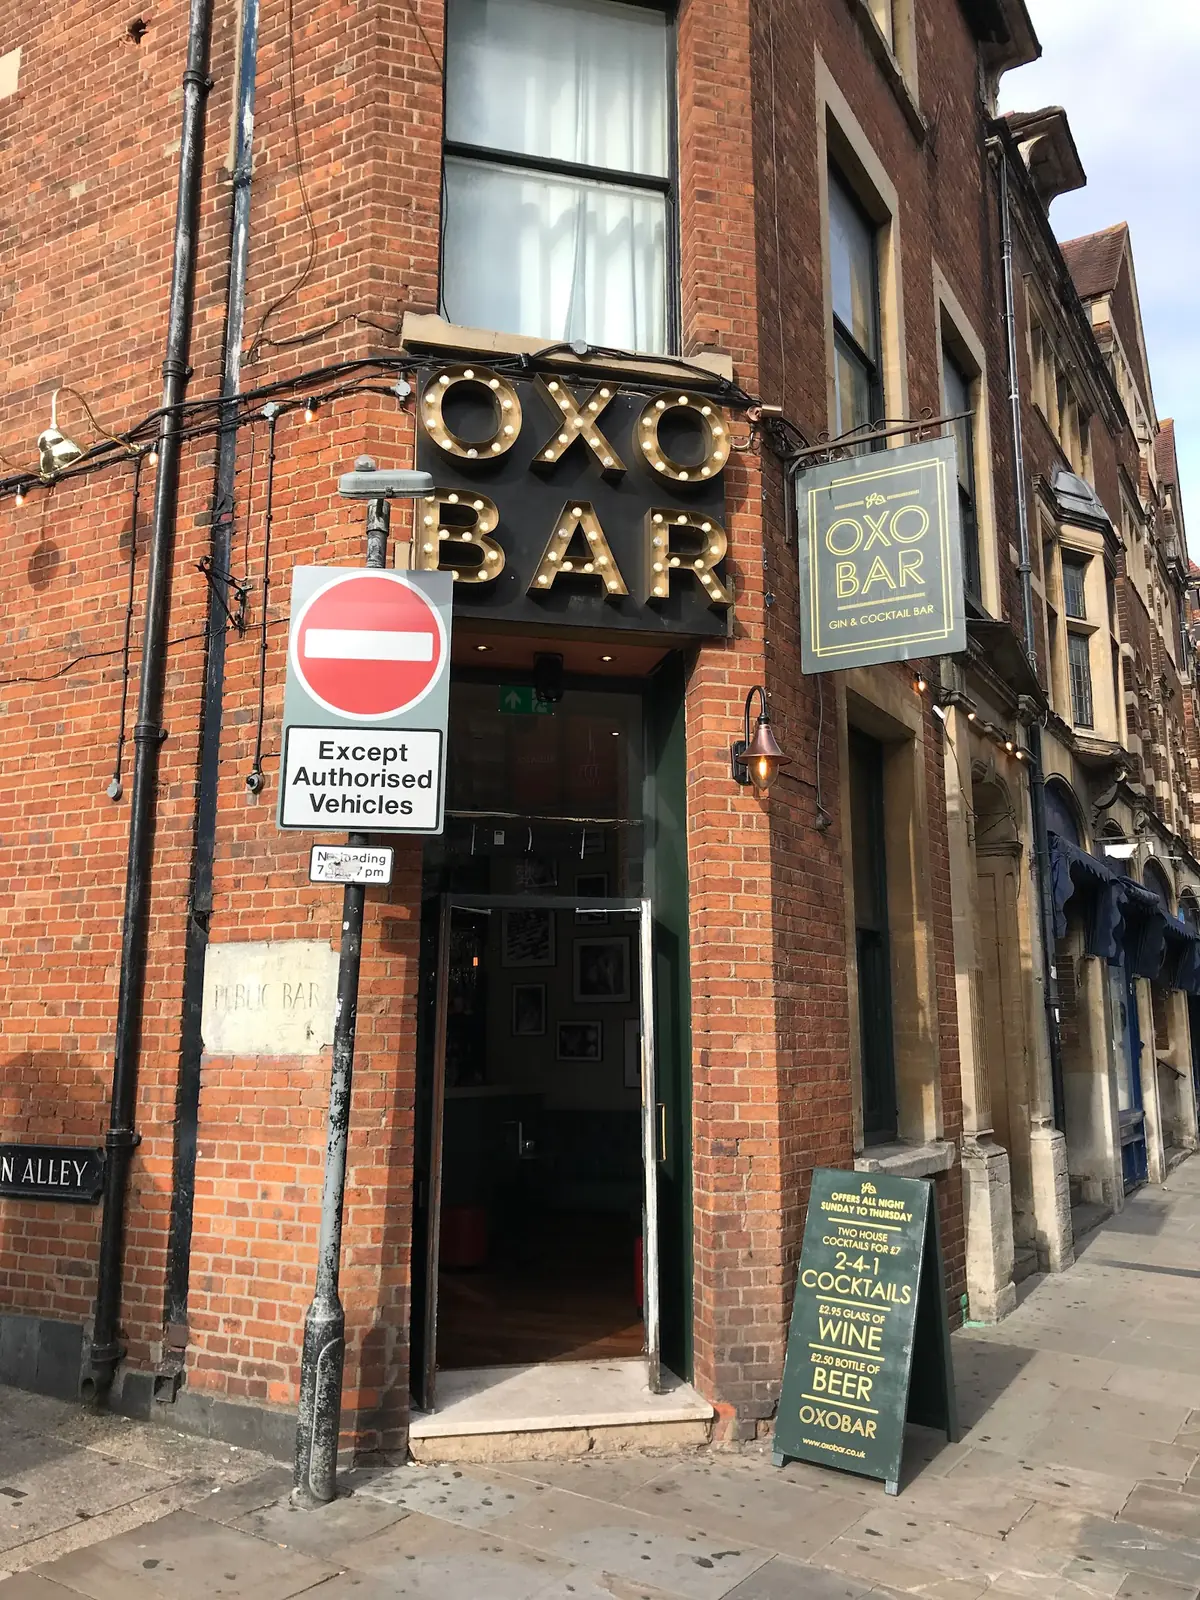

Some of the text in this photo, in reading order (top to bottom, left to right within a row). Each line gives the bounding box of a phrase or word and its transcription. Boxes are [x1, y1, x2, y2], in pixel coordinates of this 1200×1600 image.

[420, 364, 731, 482] OXO
[825, 504, 930, 556] OXO
[415, 487, 733, 610] BAR
[835, 548, 926, 599] BAR
[828, 604, 934, 630] GIN & COCKTAIL BAR
[318, 740, 409, 766] Except
[292, 766, 433, 789] Authorised
[309, 793, 414, 815] Vehicles
[365, 868, 384, 878] pm
[214, 982, 320, 1011] PUBLIC BAR
[21, 1157, 89, 1187] ALLEY
[820, 1201, 913, 1222] SUNDAY TO THURSDAY
[831, 1191, 905, 1210] OFFERS ALL NIGHT
[822, 1236, 901, 1255] COCKTAILS FOR £7
[838, 1226, 888, 1242] TWO HOUSE
[834, 1251, 880, 1276] 2-4-1
[801, 1269, 912, 1305] COCKTAILS
[818, 1304, 886, 1325] £2.95 GLASS OF
[818, 1316, 883, 1352] WINE
[810, 1352, 880, 1374] £2.50 BOTTLE OF
[812, 1366, 873, 1402] BEER
[799, 1405, 877, 1439] OXOBAR
[802, 1437, 866, 1459] www.oxobar.co.uk
